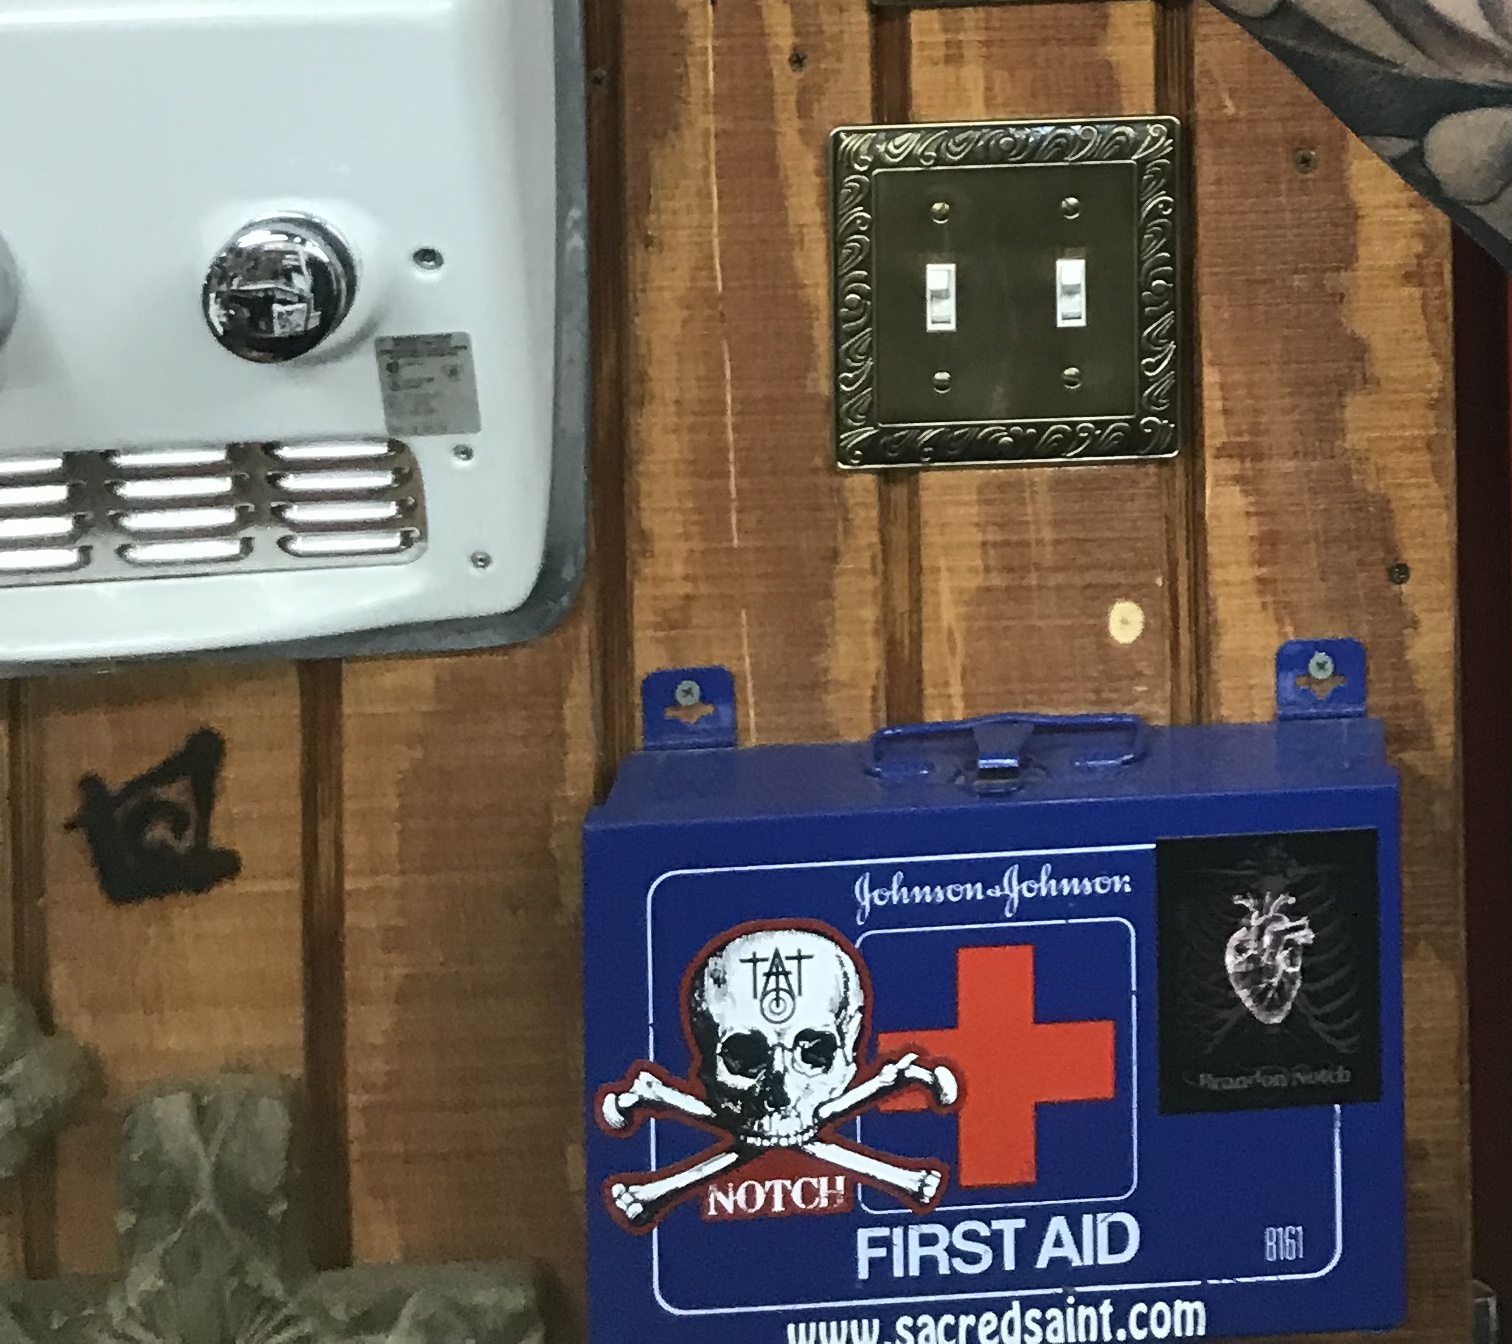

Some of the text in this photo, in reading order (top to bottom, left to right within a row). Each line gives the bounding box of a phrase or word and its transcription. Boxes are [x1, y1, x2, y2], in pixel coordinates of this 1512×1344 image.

[707, 1175, 846, 1216] NOTCH
[856, 1212, 1141, 1280] FIRST AID
[1263, 1225, 1305, 1262] 8161
[786, 1295, 1207, 1344] www.sacredsaint.com
